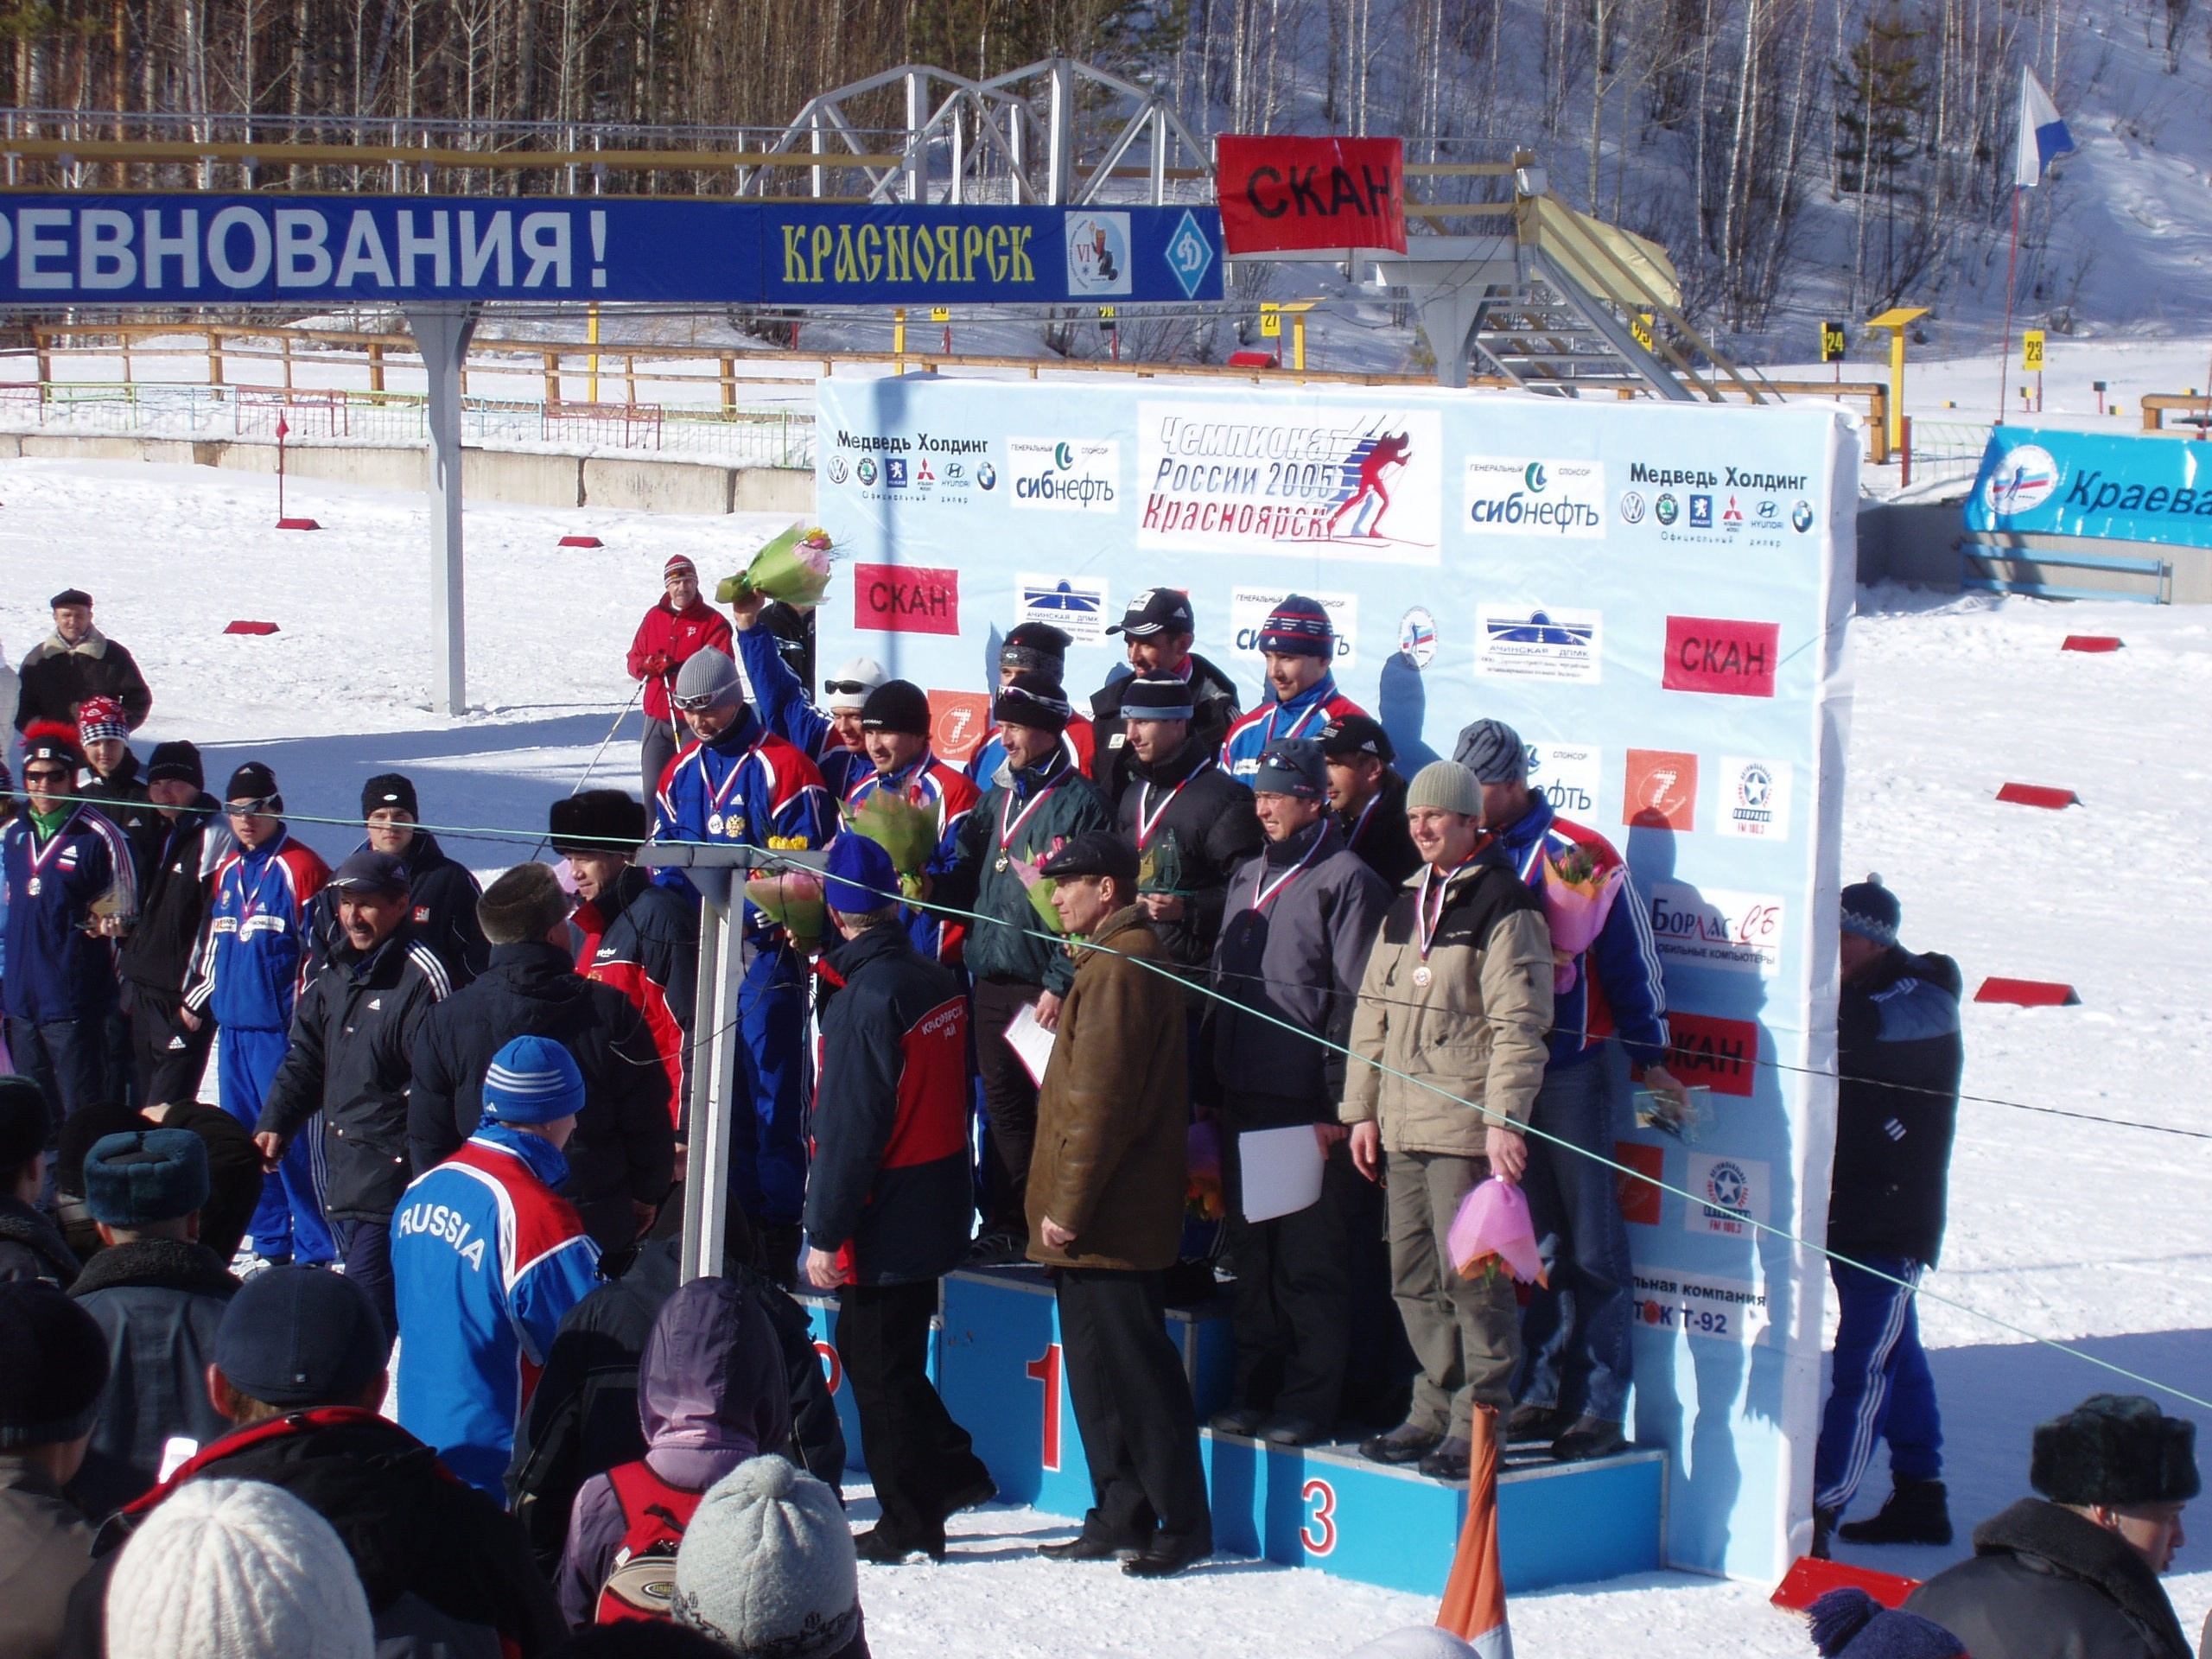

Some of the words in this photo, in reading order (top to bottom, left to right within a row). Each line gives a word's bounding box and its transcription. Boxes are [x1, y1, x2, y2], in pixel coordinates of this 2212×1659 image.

[1245, 166, 1394, 219] СКАН
[0, 206, 607, 290] ЕВНОВАНИЯ!
[781, 223, 1036, 283] КРАСНОЯРСК
[1827, 331, 1844, 353] 24
[2026, 340, 2043, 361] 23
[836, 430, 912, 454] Медведь
[917, 432, 989, 455] Холдинг
[1160, 416, 1352, 463] Чемпионат
[1015, 469, 1115, 508] сибнефть
[1152, 457, 1260, 494] России
[1265, 461, 1339, 499] 2005
[1630, 462, 1719, 489] Медведь
[1725, 466, 1808, 493] Холдинг
[1141, 493, 1330, 540] Красноярск
[1471, 491, 1599, 534] сибнефть
[868, 582, 948, 618] СКАН
[1489, 645, 1549, 655] АЧИНСКАЯ
[1680, 637, 1766, 677] СКАН
[1657, 943, 1707, 957] ОБИЛЬНЫЕ
[1709, 950, 1776, 965] КОМПЬЮТЕРЫ
[1666, 1033, 1744, 1075] КАН
[398, 1203, 486, 1273] RUSSIA
[1633, 1275, 1677, 1294] льная
[1682, 1283, 1767, 1307] компания
[1680, 1307, 1727, 1334] Т-92
[1026, 1343, 1062, 1471] 1
[1299, 1478, 1338, 1557] 3
